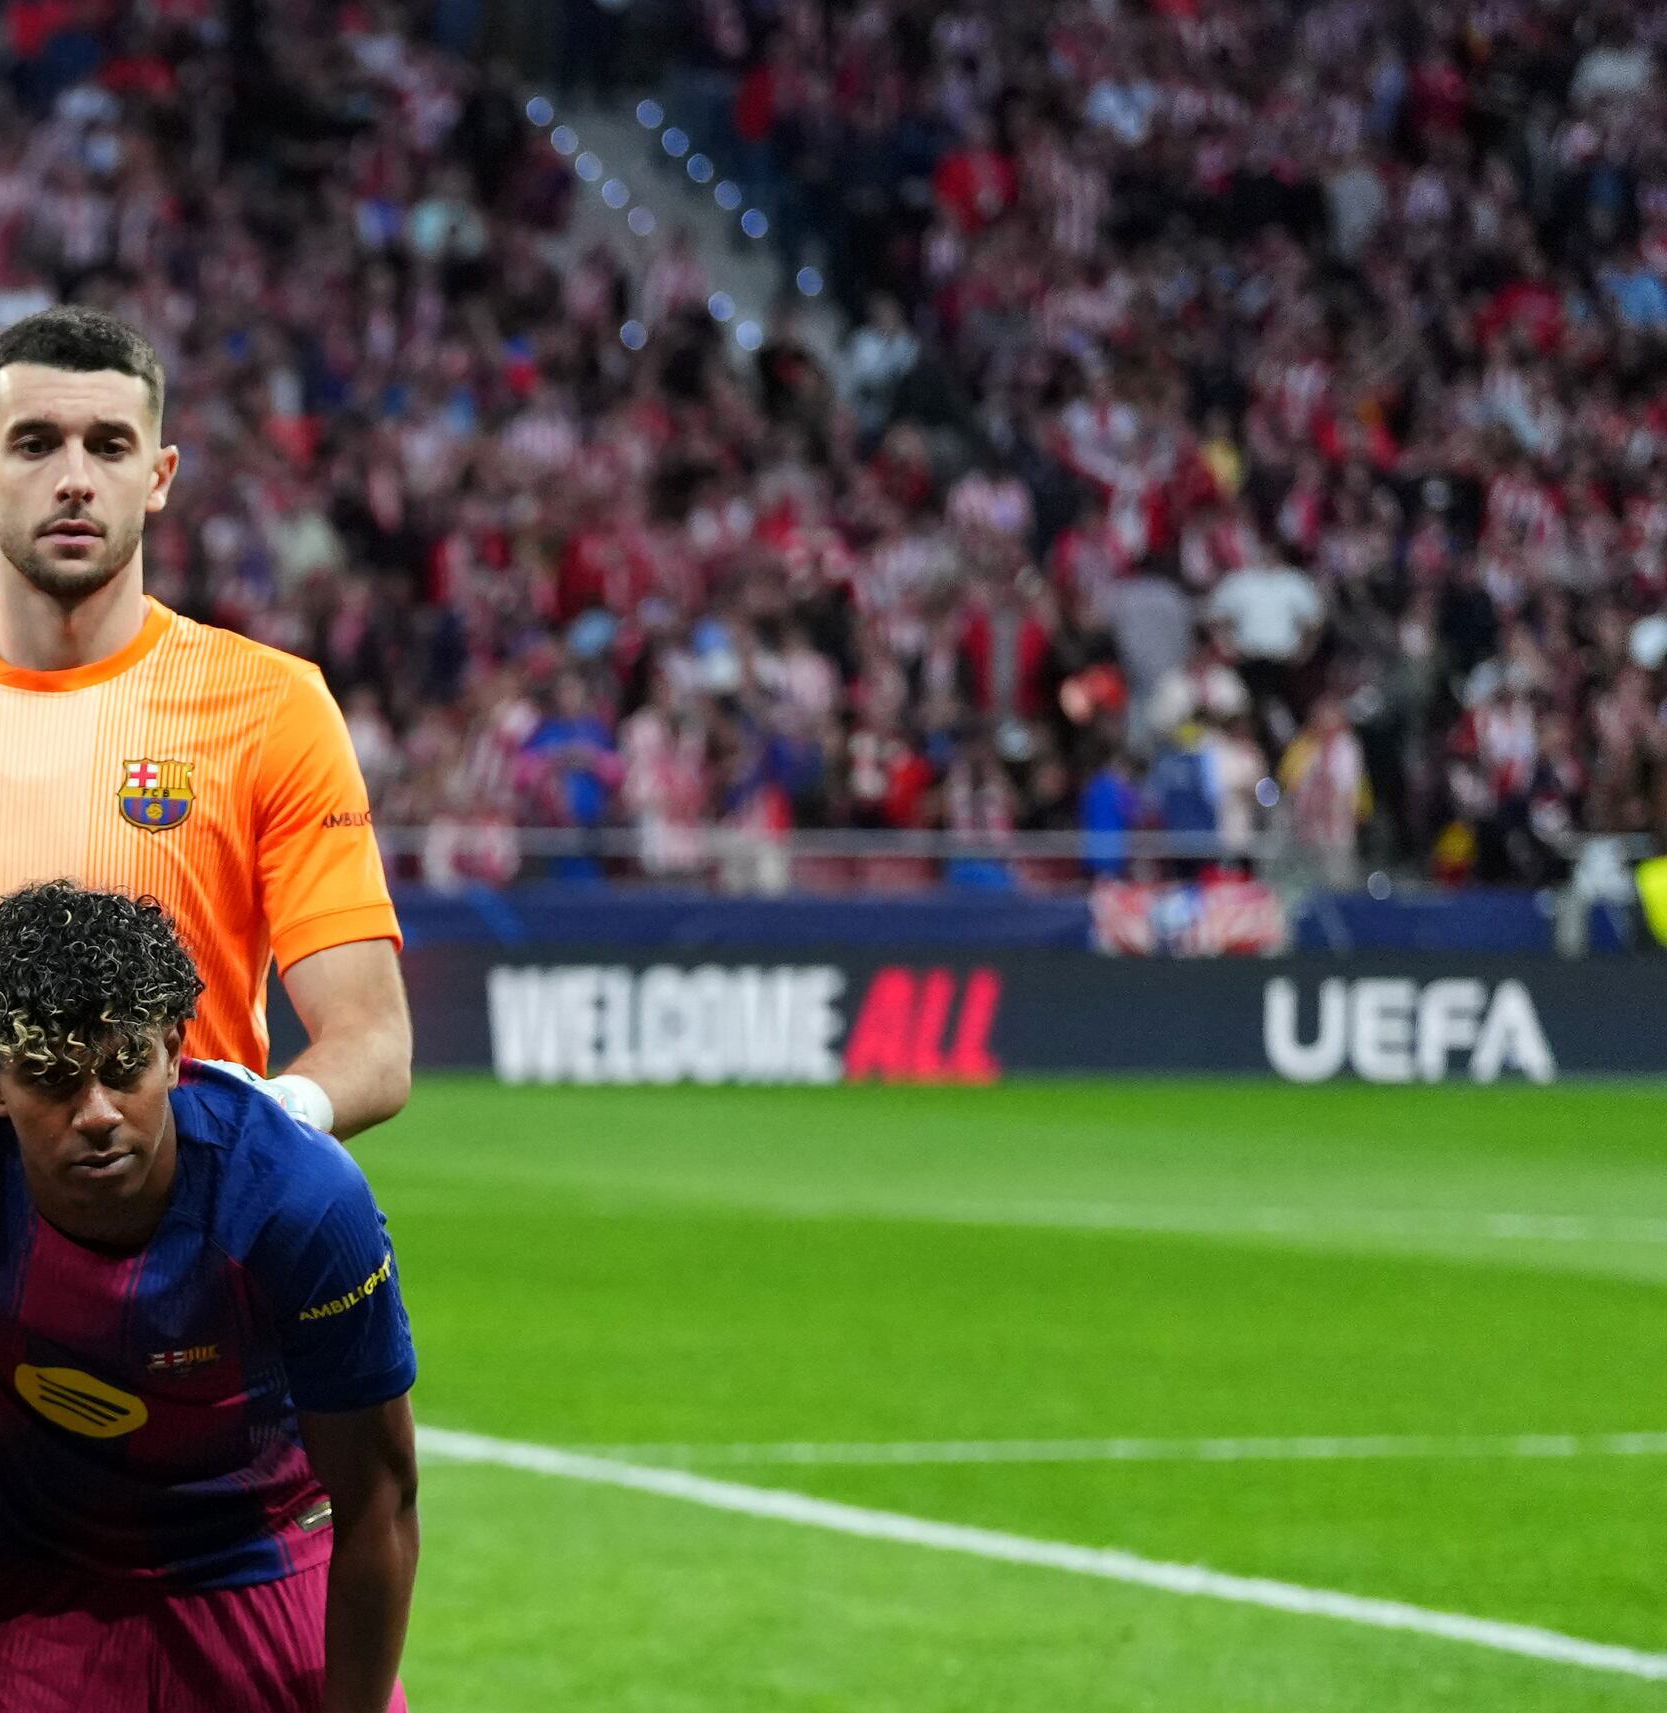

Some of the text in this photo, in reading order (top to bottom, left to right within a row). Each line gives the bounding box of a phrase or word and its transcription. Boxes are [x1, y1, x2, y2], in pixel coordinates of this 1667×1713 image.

[485, 964, 1003, 1084] WELCOME ALL
[1264, 976, 1555, 1084] UEFA
